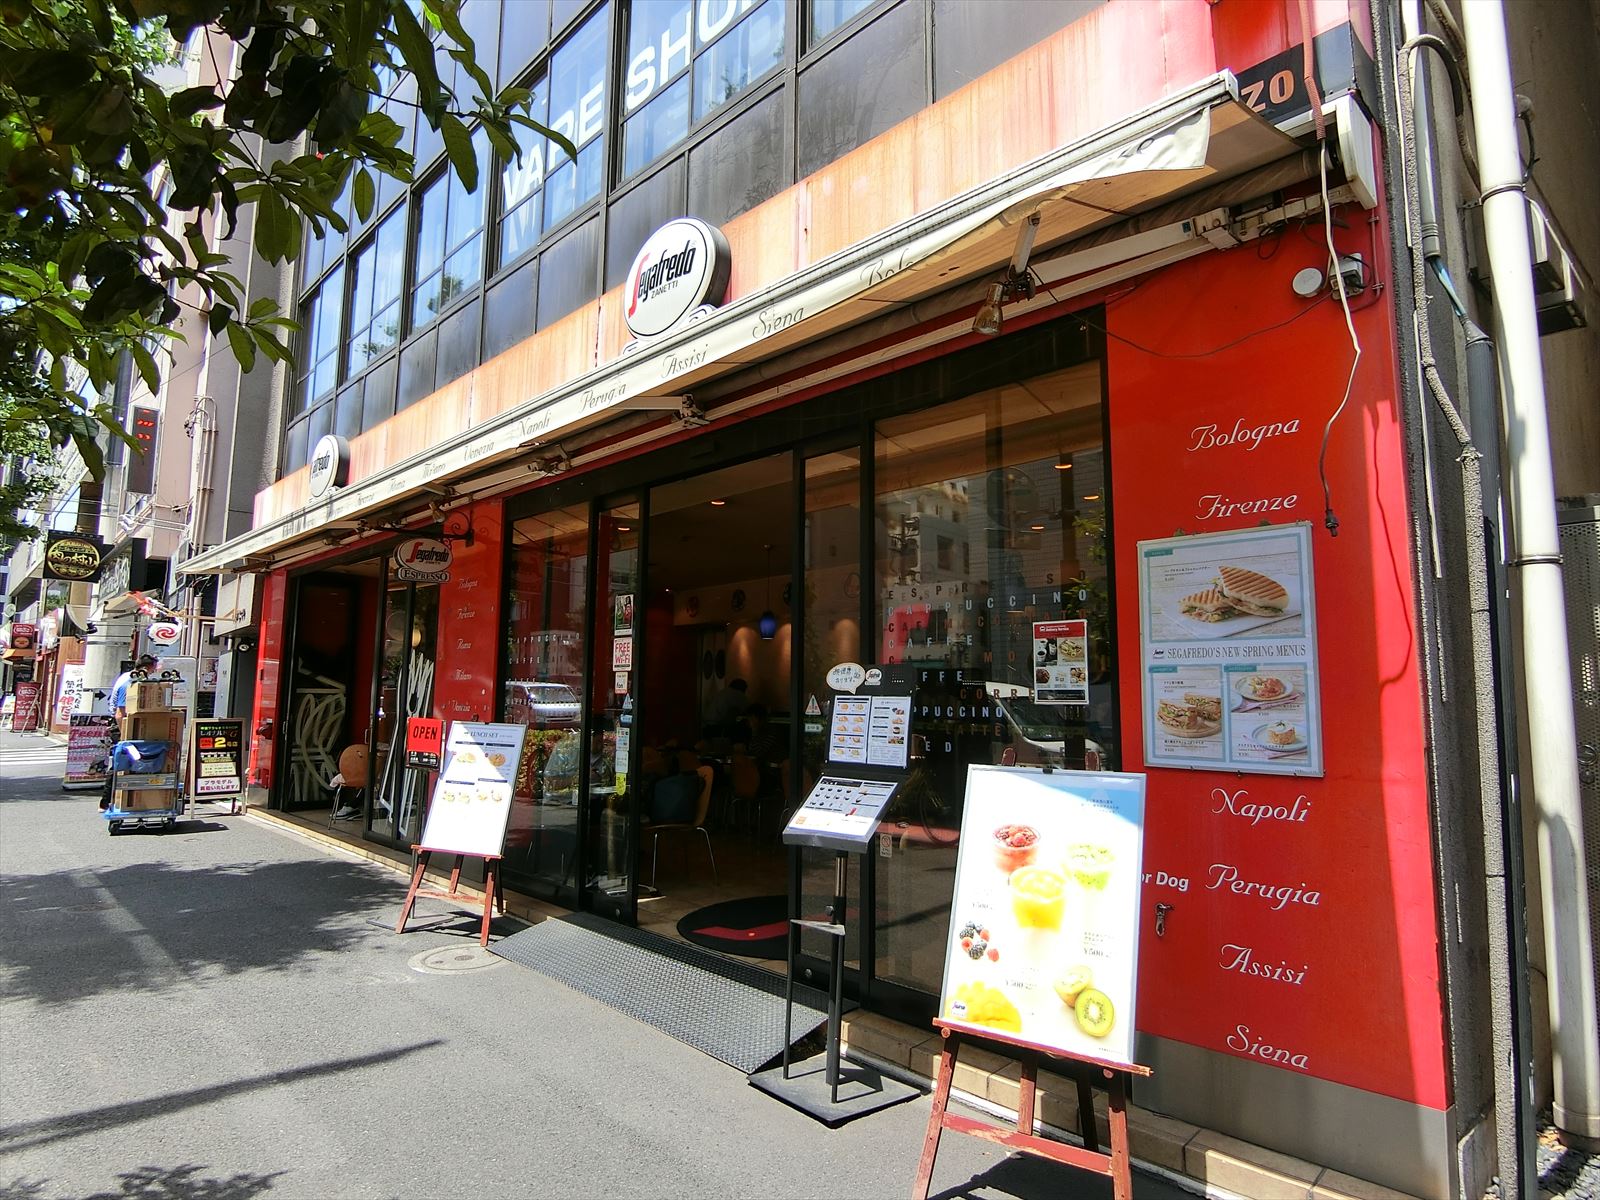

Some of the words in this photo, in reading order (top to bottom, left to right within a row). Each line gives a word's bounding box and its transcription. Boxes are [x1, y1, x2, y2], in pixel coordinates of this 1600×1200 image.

[502, 80, 604, 210] VAPE
[626, 0, 752, 111] SHO
[650, 279, 679, 300] ZANETTI
[751, 305, 805, 340] Siena
[661, 344, 709, 379] Assisi
[579, 382, 628, 413] Perugia
[518, 410, 552, 438] Napoli
[1187, 418, 1301, 452] Bologna
[1195, 493, 1298, 521] Firenze
[404, 569, 448, 581] ESPRESSO
[615, 642, 630, 653] FREE
[1221, 646, 1241, 658] NEW
[1242, 645, 1274, 657] SPRING
[1276, 644, 1306, 657] MENUS
[413, 726, 438, 740] OPEN
[1210, 787, 1312, 826] Napoli
[1156, 871, 1189, 893] Dog
[1205, 863, 1322, 911] Perugia
[1219, 943, 1310, 986] Assisi
[1226, 1024, 1309, 1071] Siena
